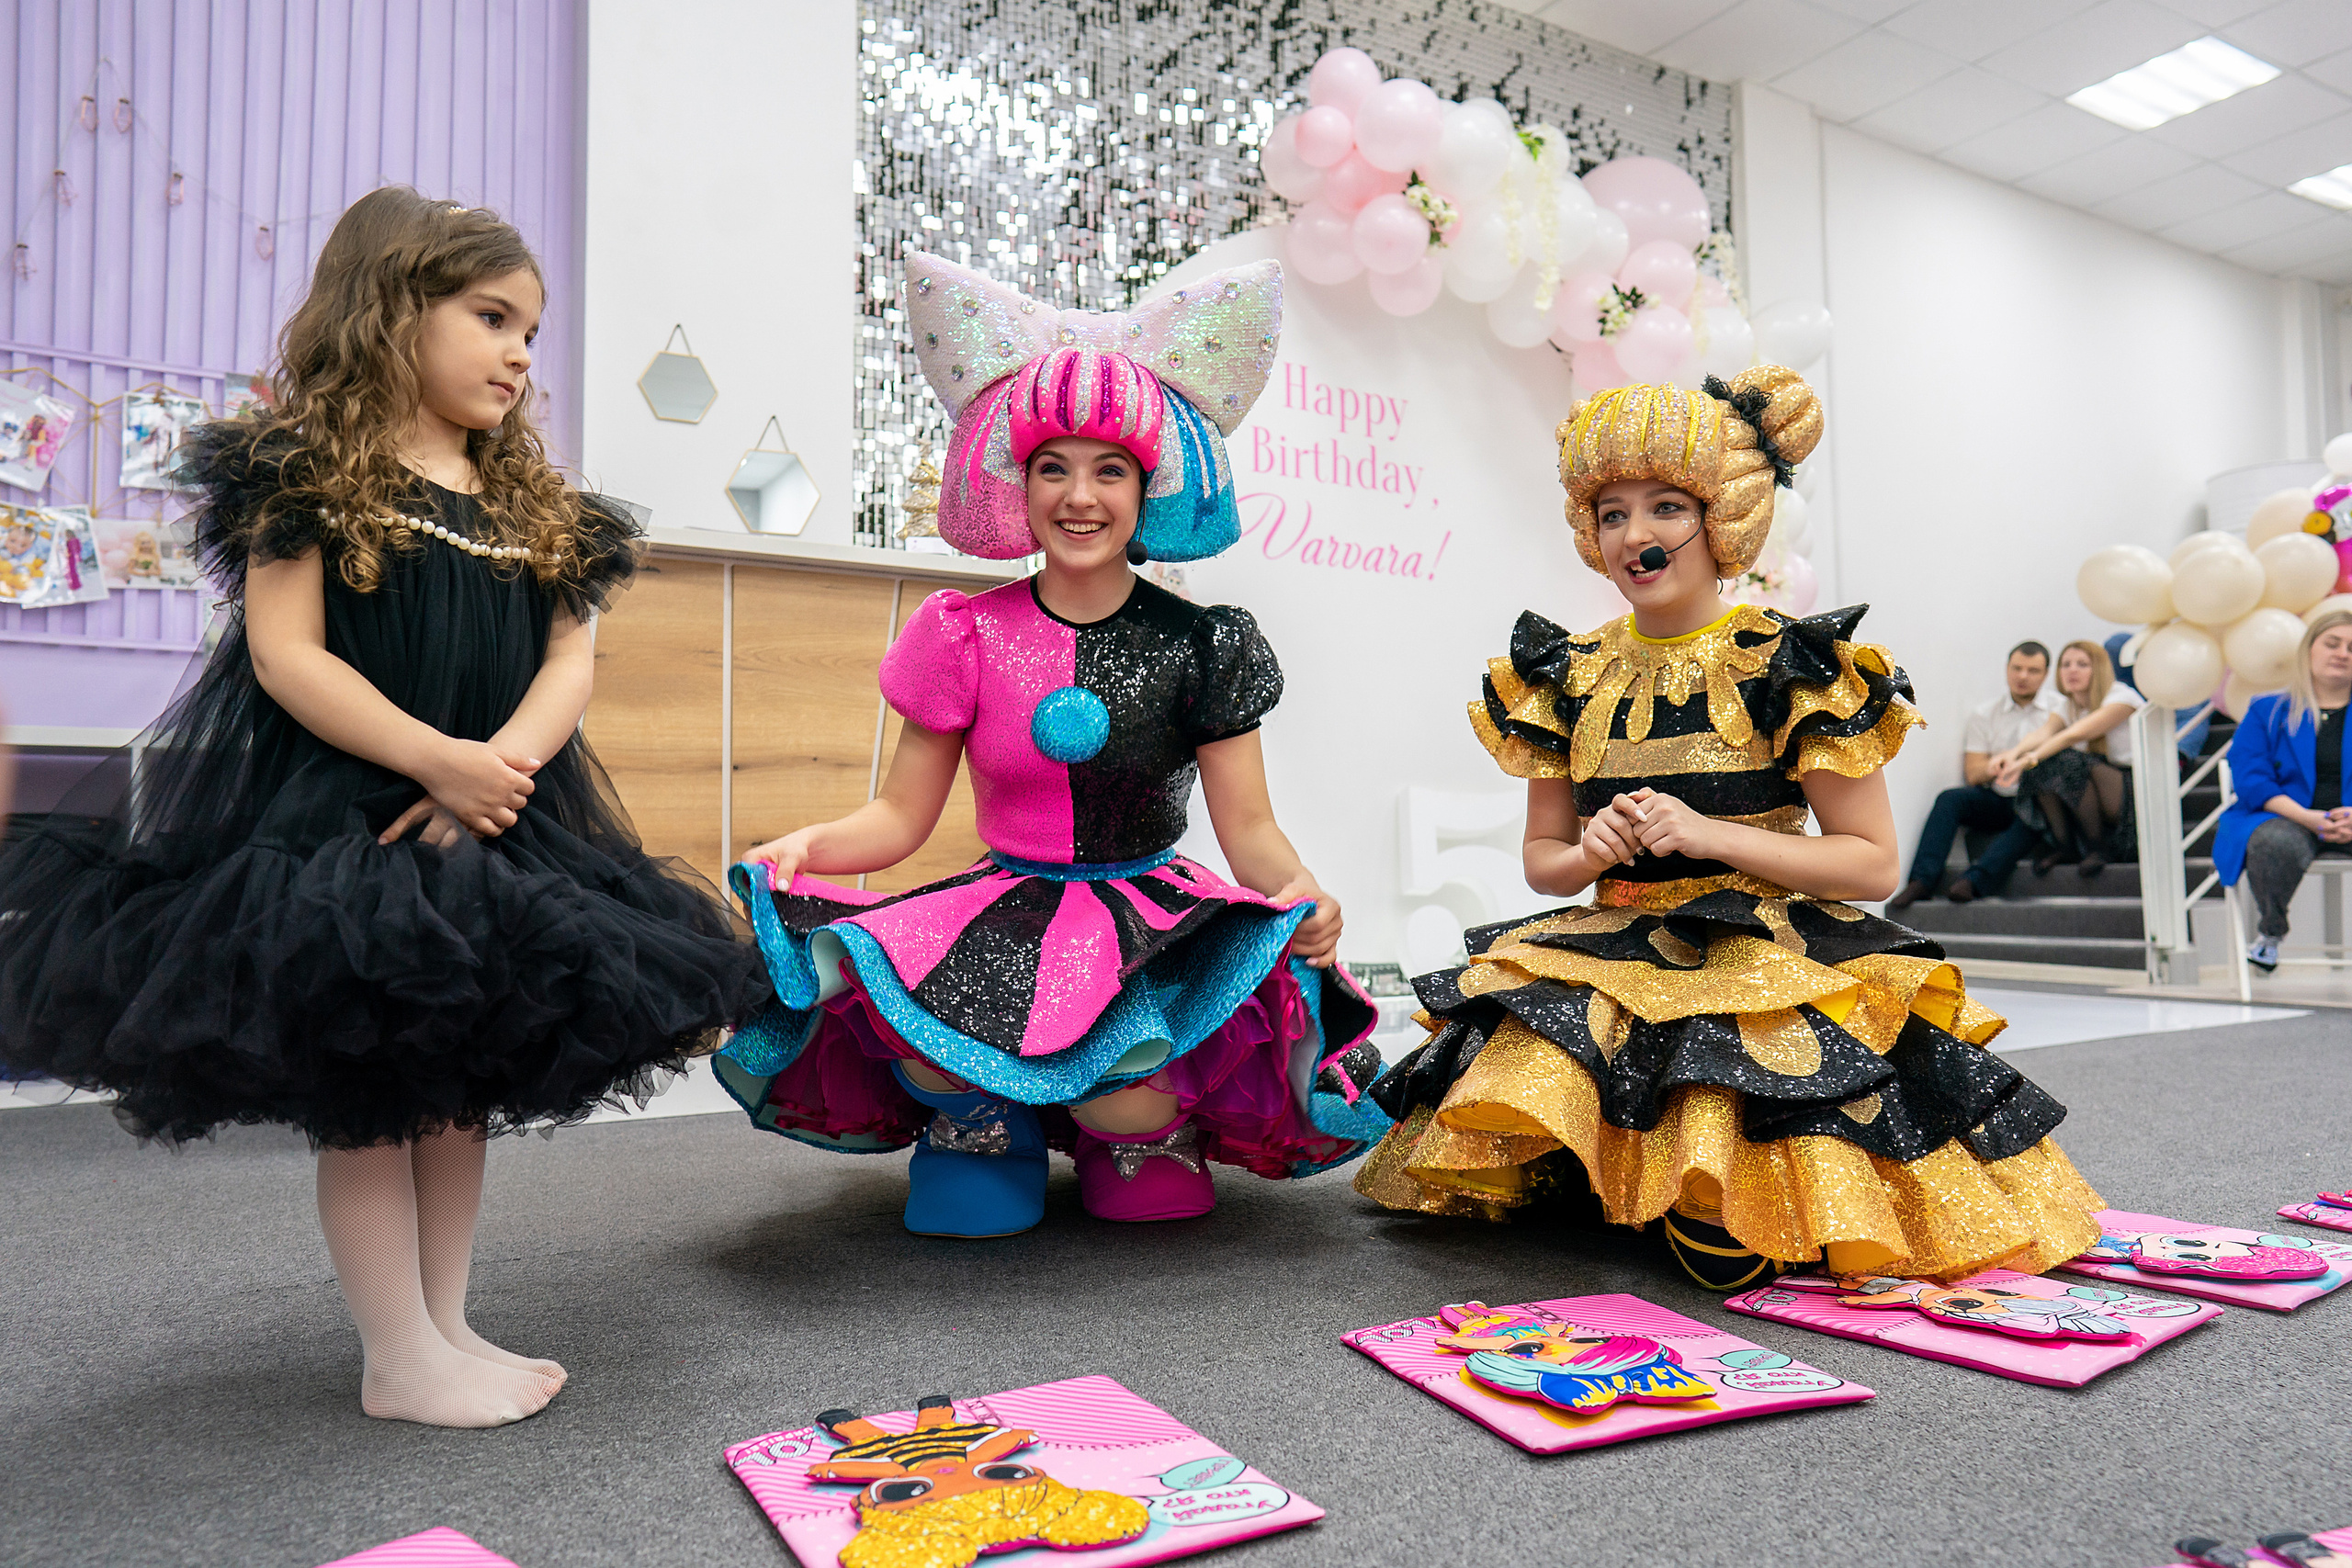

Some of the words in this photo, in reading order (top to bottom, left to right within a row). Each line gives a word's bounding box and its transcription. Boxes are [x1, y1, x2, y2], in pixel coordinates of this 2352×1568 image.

[1283, 361, 1408, 441] Happy
[1250, 424, 1439, 509] Birthday,
[1237, 491, 1452, 581] Varvara!
[1162, 1495, 1196, 1509] Я?
[1205, 1488, 1251, 1500] кто
